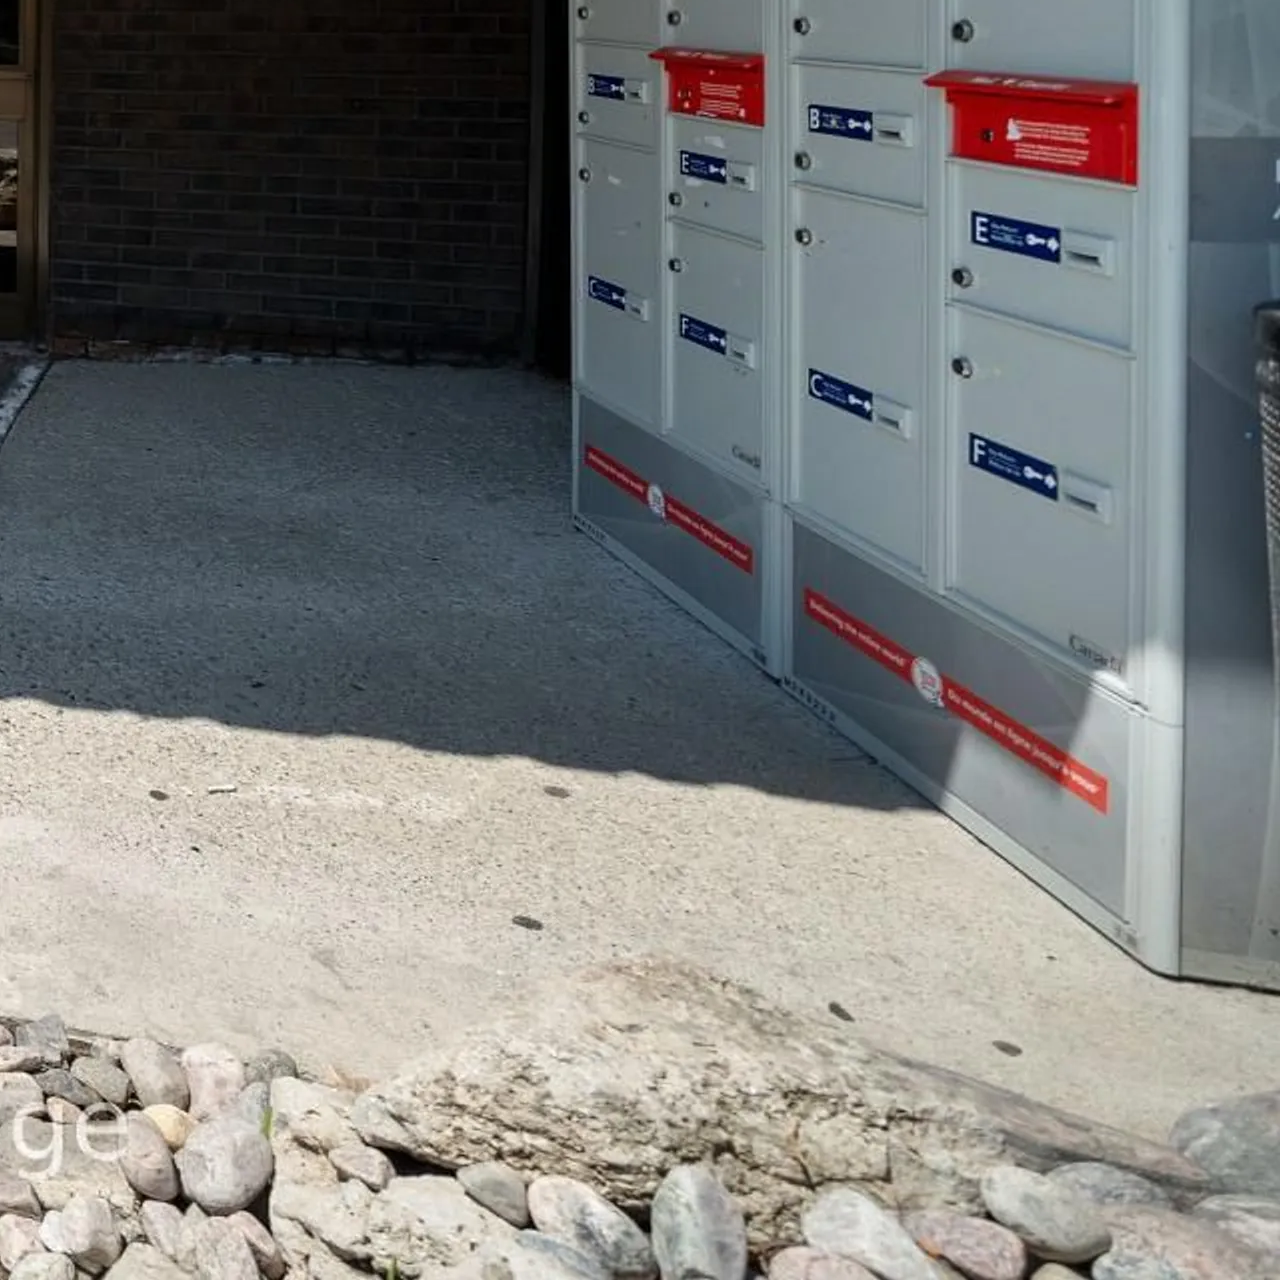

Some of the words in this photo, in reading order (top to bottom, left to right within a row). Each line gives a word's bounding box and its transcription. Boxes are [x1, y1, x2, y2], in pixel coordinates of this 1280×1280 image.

[810, 108, 820, 129] B
[976, 216, 989, 243] E
[811, 374, 824, 398] C
[973, 438, 986, 464] F
